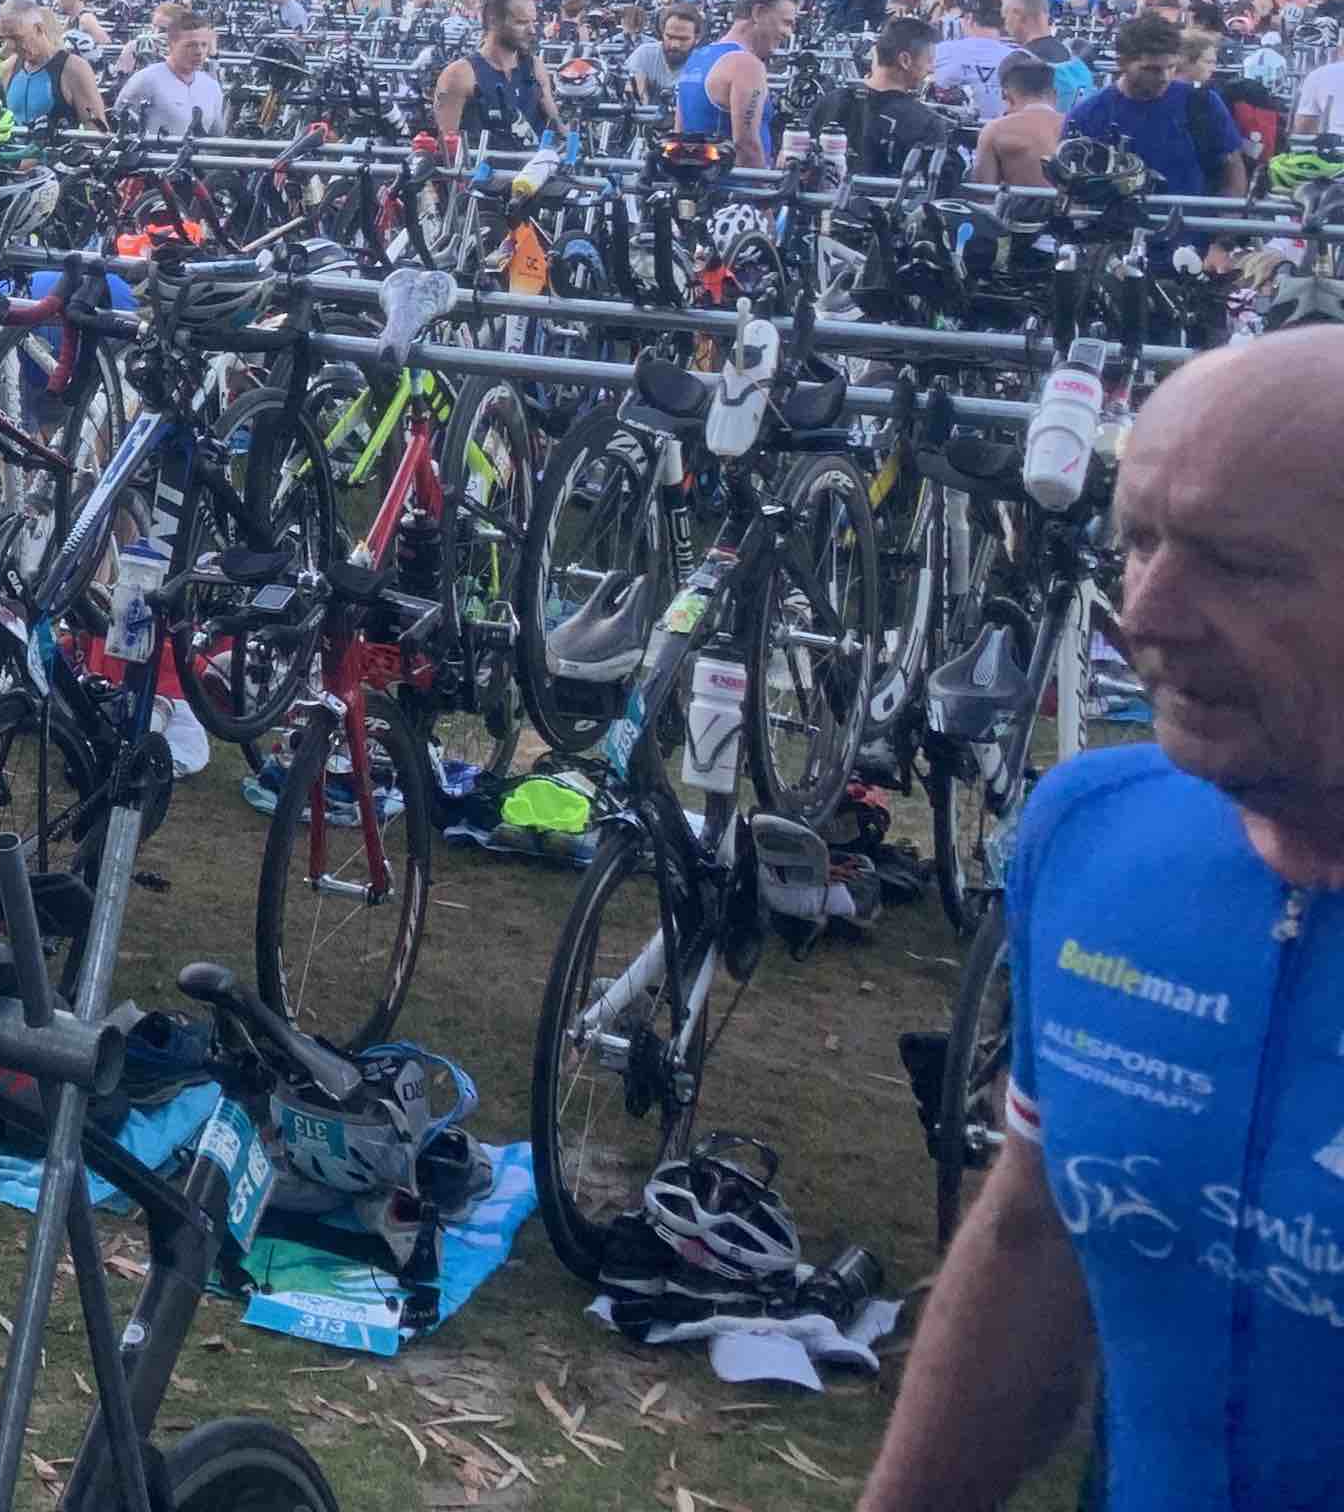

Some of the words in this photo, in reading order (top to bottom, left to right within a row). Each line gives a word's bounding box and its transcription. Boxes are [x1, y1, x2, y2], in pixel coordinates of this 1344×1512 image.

[1058, 938, 1232, 1025] Bottlemart
[295, 1113, 328, 1136] 313
[299, 1313, 346, 1334] 313
